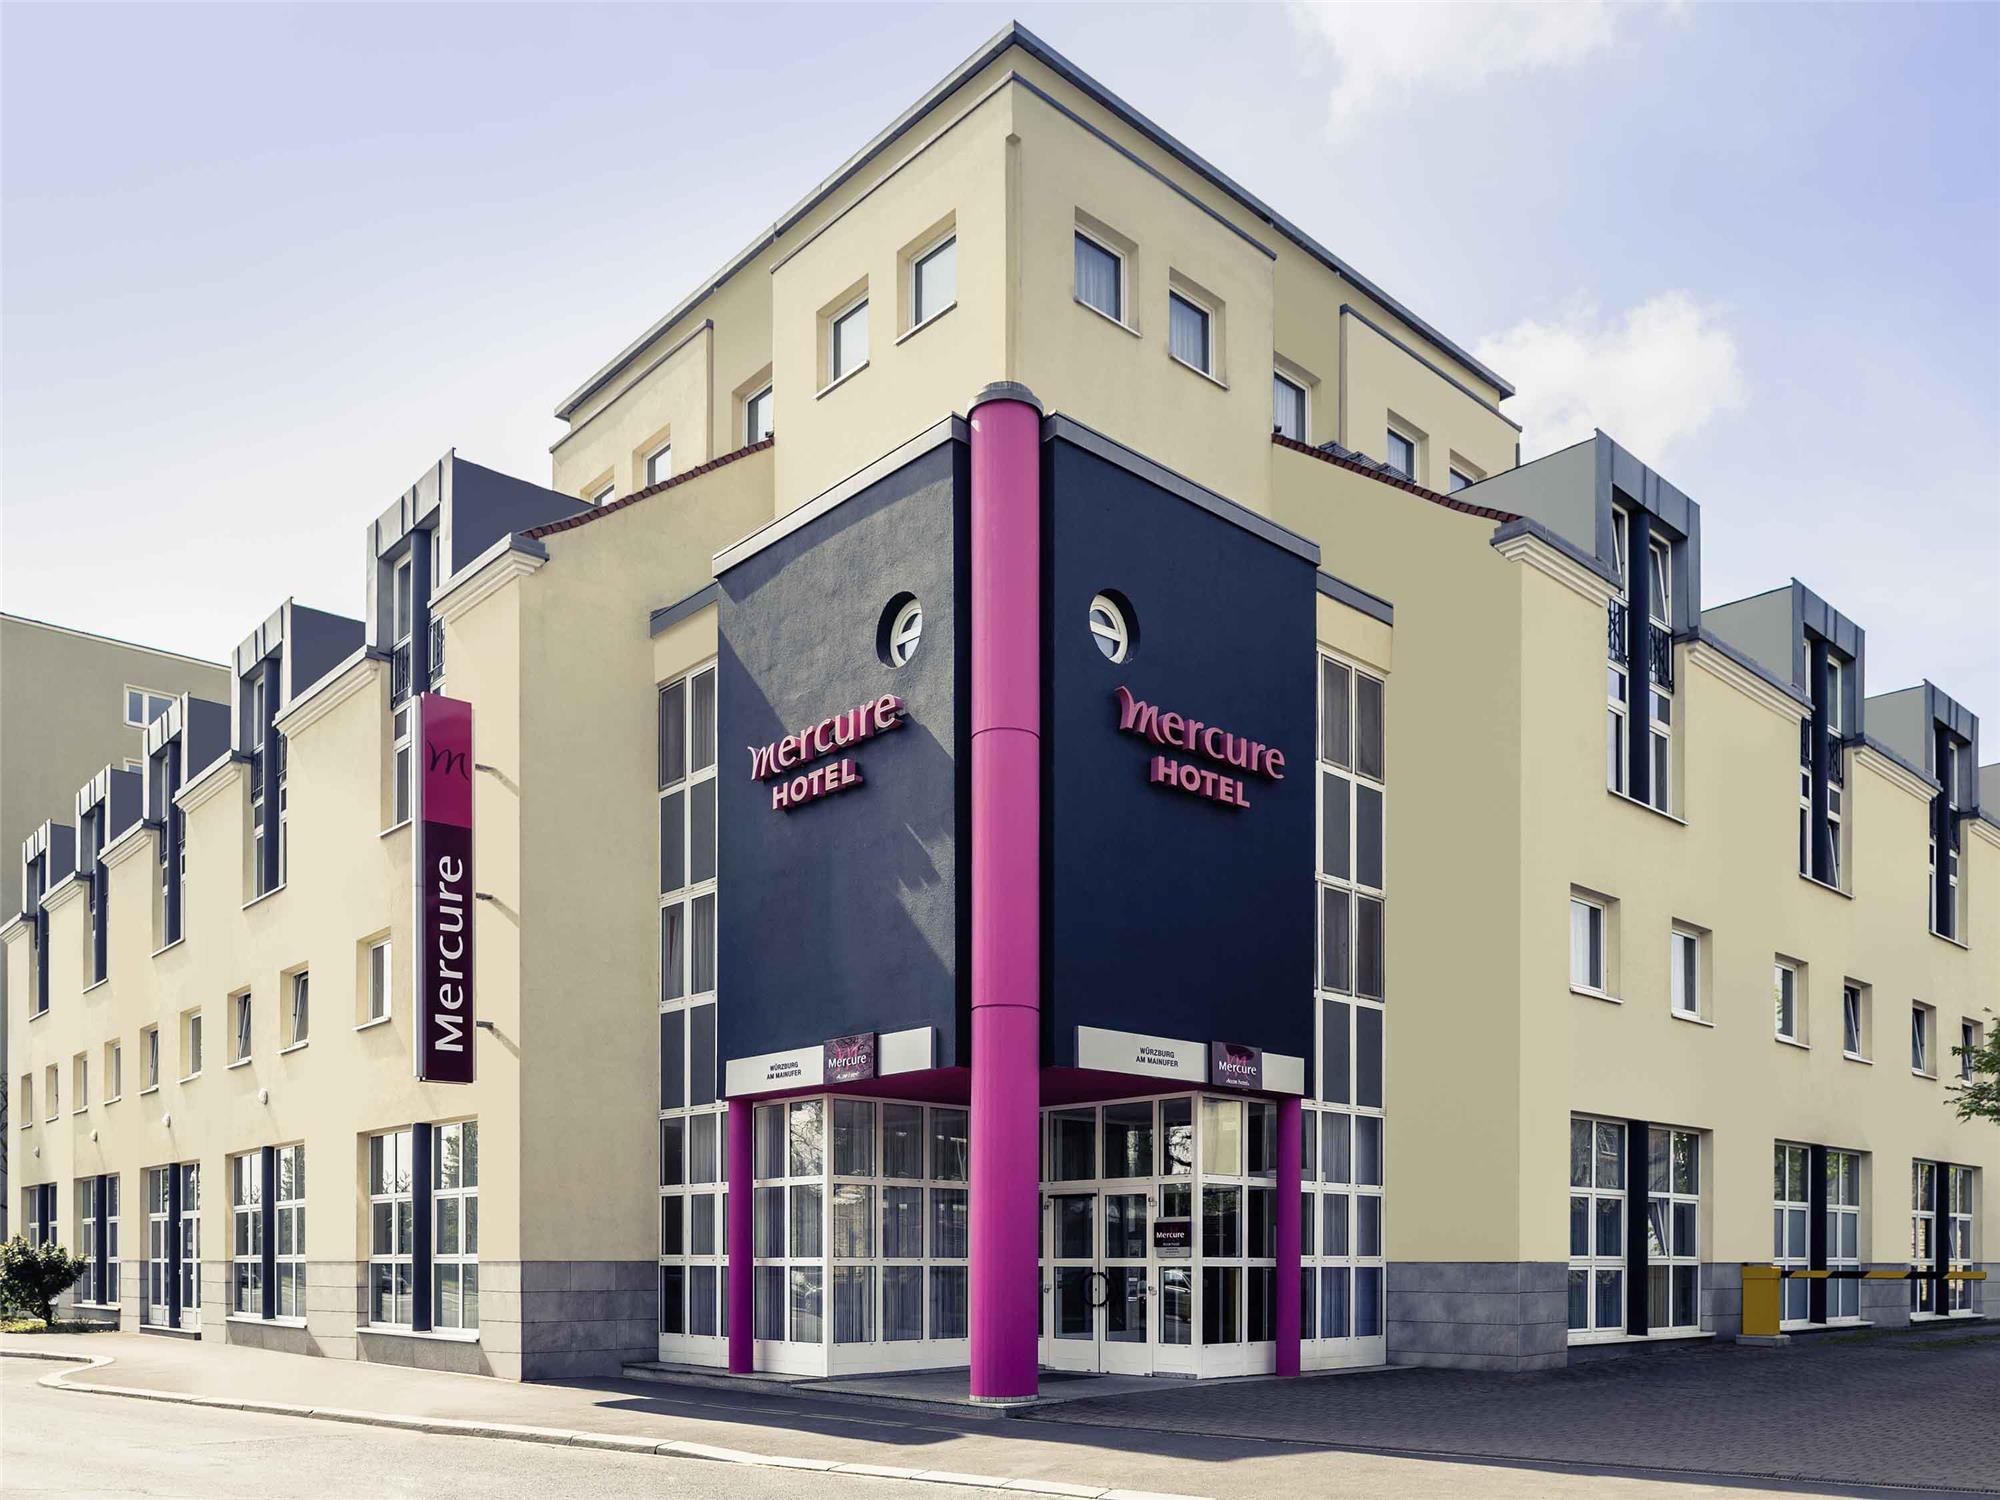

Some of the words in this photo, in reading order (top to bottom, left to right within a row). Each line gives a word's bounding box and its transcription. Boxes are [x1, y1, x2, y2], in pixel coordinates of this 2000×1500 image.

[772, 758, 863, 810] HOTEL
[1151, 756, 1250, 808] HOTEL
[435, 855, 464, 1053] Mercure
[1139, 1046, 1175, 1059] WÜRZBURG
[828, 1054, 867, 1069] Mercure
[1135, 1055, 1146, 1063] AM
[1147, 1057, 1179, 1068] MAINUFER
[1218, 1060, 1257, 1076] Mercure
[766, 1072, 775, 1080] AM
